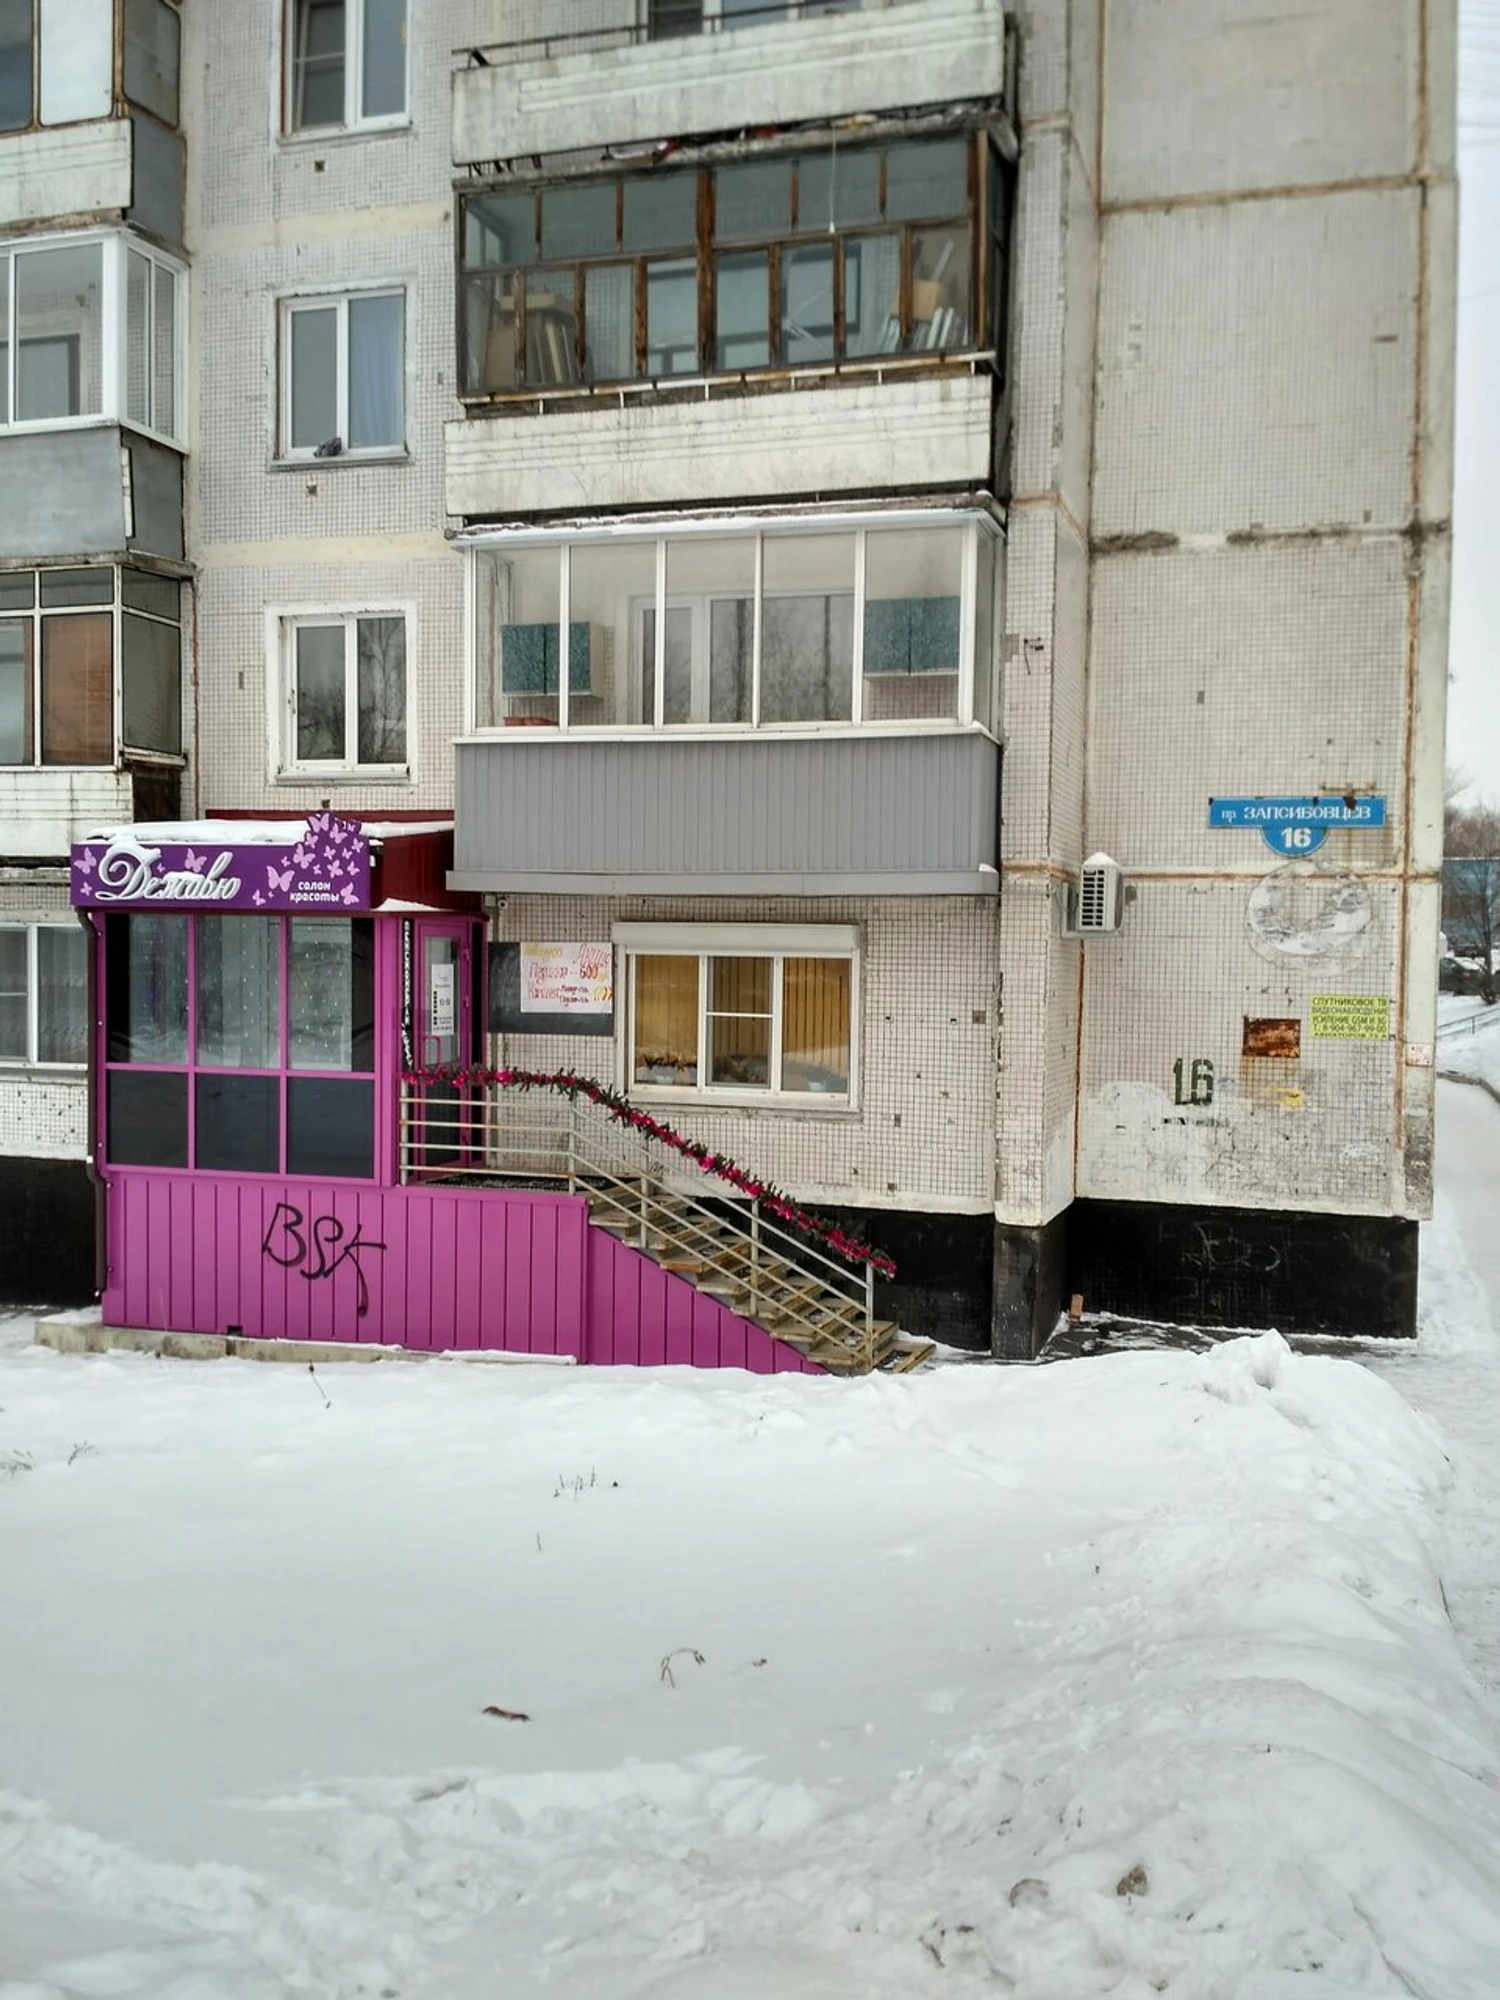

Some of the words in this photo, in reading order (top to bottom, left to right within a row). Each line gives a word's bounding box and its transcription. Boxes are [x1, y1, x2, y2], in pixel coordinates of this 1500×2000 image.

[1243, 805, 1371, 821] ЗАПСИБОВЦЕВ
[1281, 827, 1312, 848] 16
[297, 880, 332, 891] салон
[289, 891, 341, 903] красоты
[1312, 996, 1374, 1006] СПУТНИКОВОЕ
[1378, 997, 1388, 1006] ТВ
[1312, 1015, 1349, 1024] УСИЛЕНИЕ
[1172, 1057, 1215, 1106] 16
